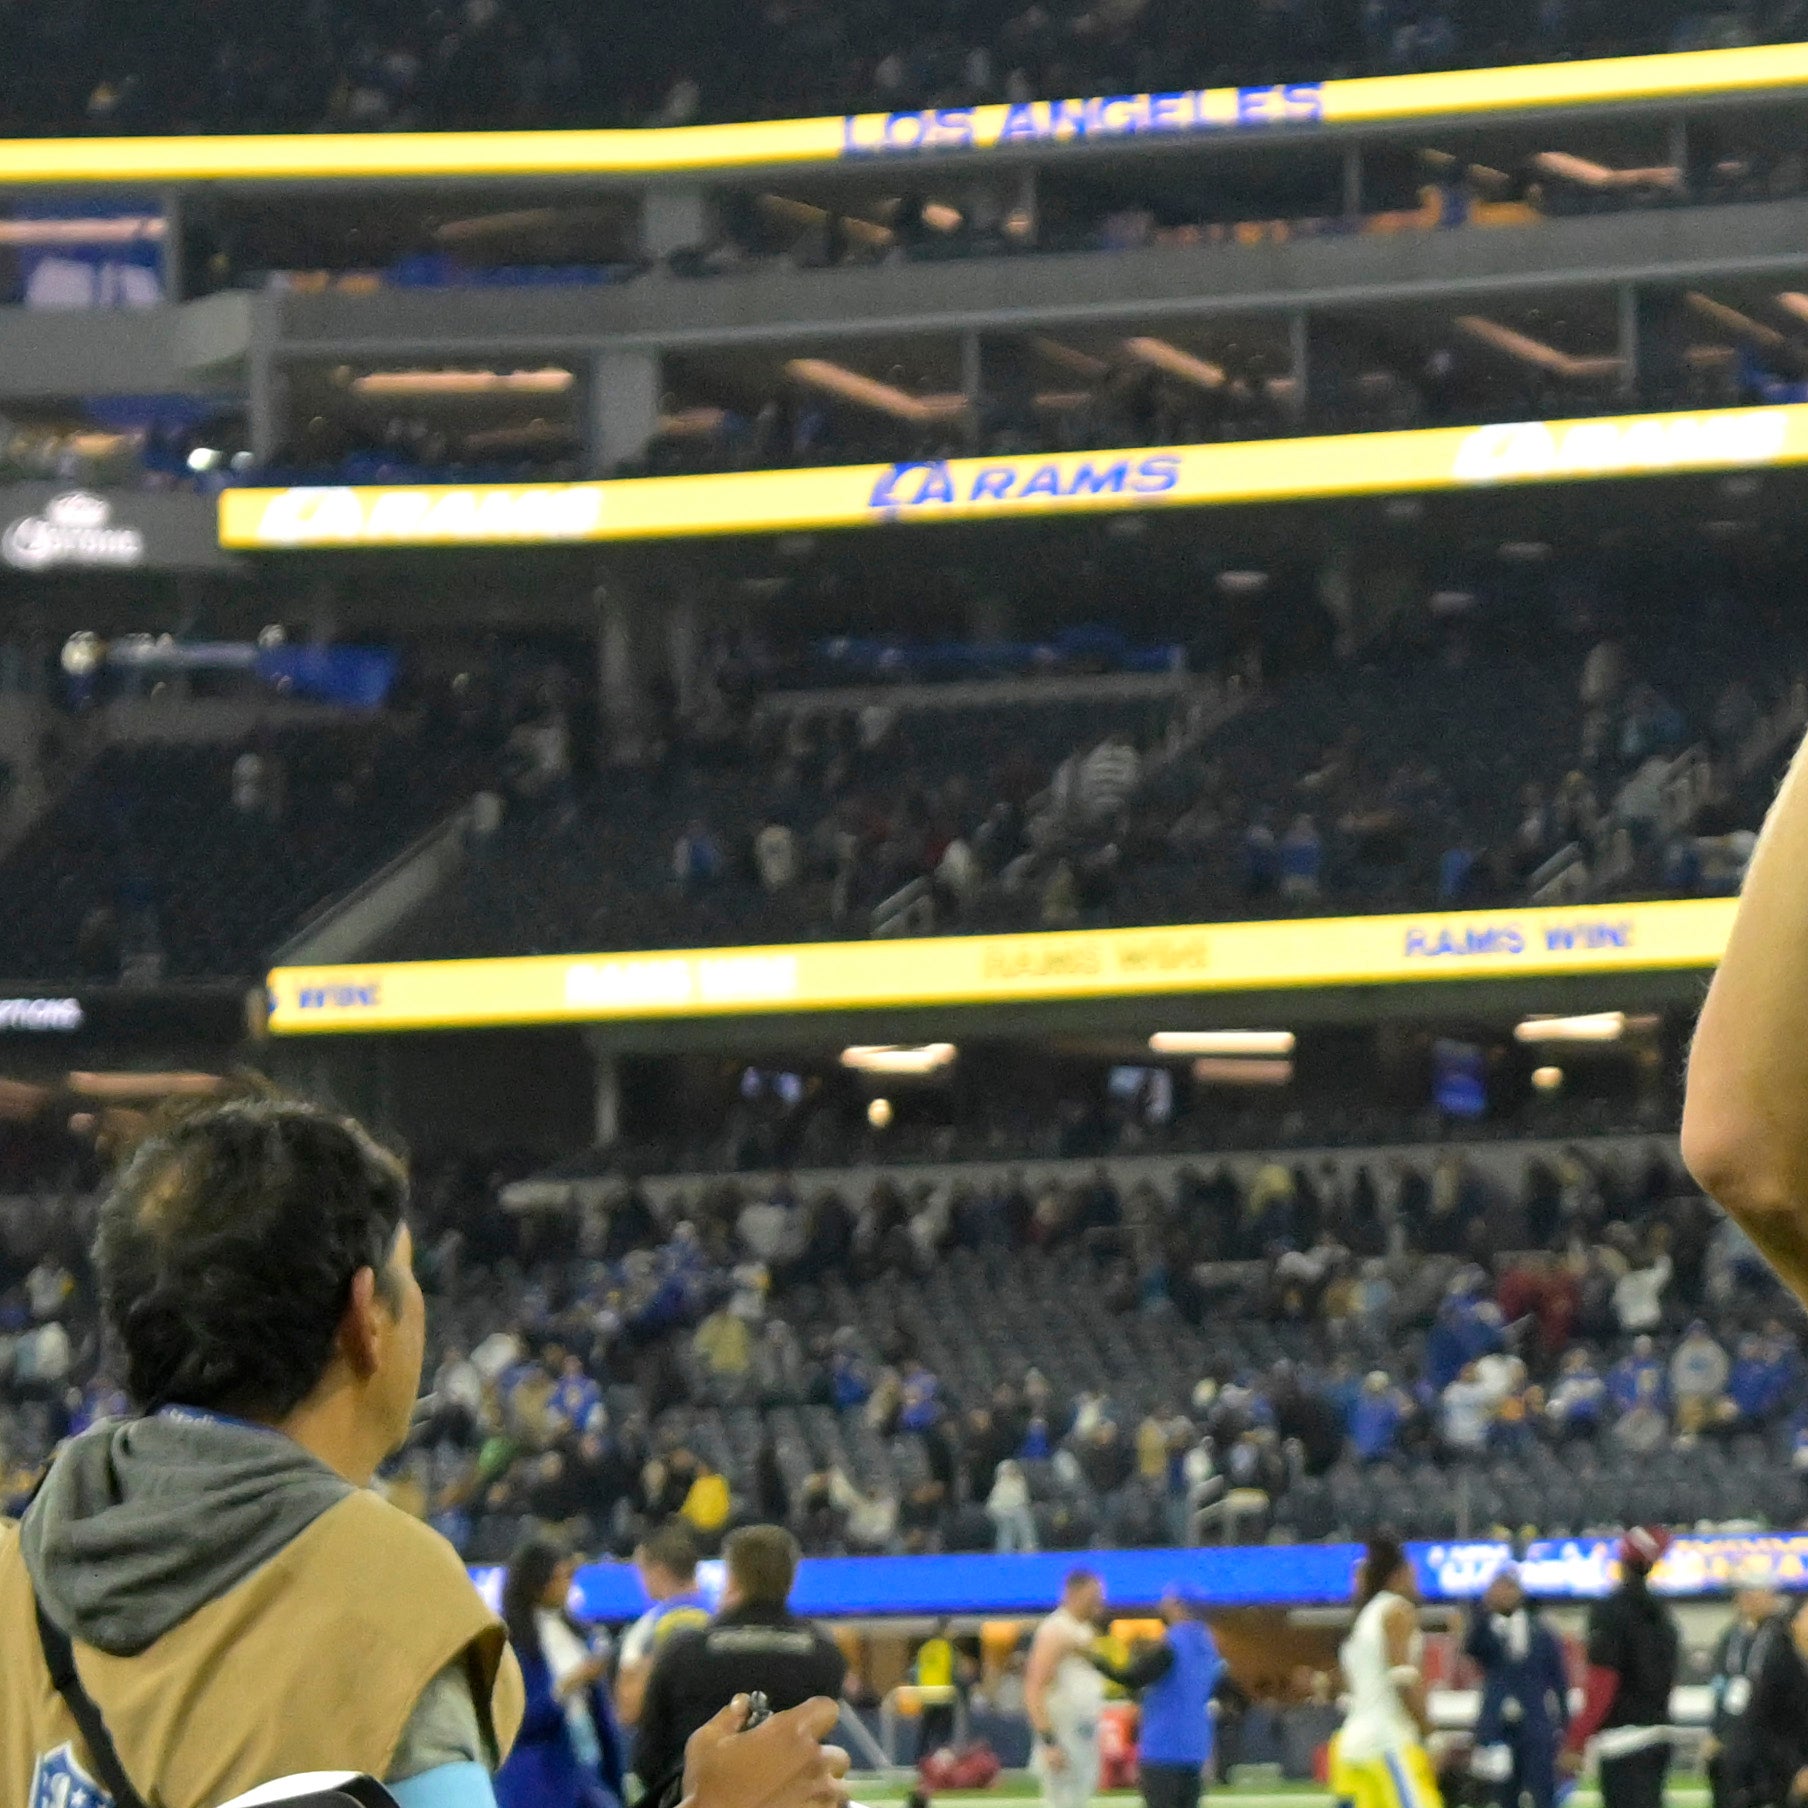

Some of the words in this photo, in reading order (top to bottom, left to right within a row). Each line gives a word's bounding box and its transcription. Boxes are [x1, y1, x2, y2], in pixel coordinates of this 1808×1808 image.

[843, 107, 977, 157] LOS
[1002, 81, 1324, 142] ANGELES
[970, 455, 1182, 501] RAMS
